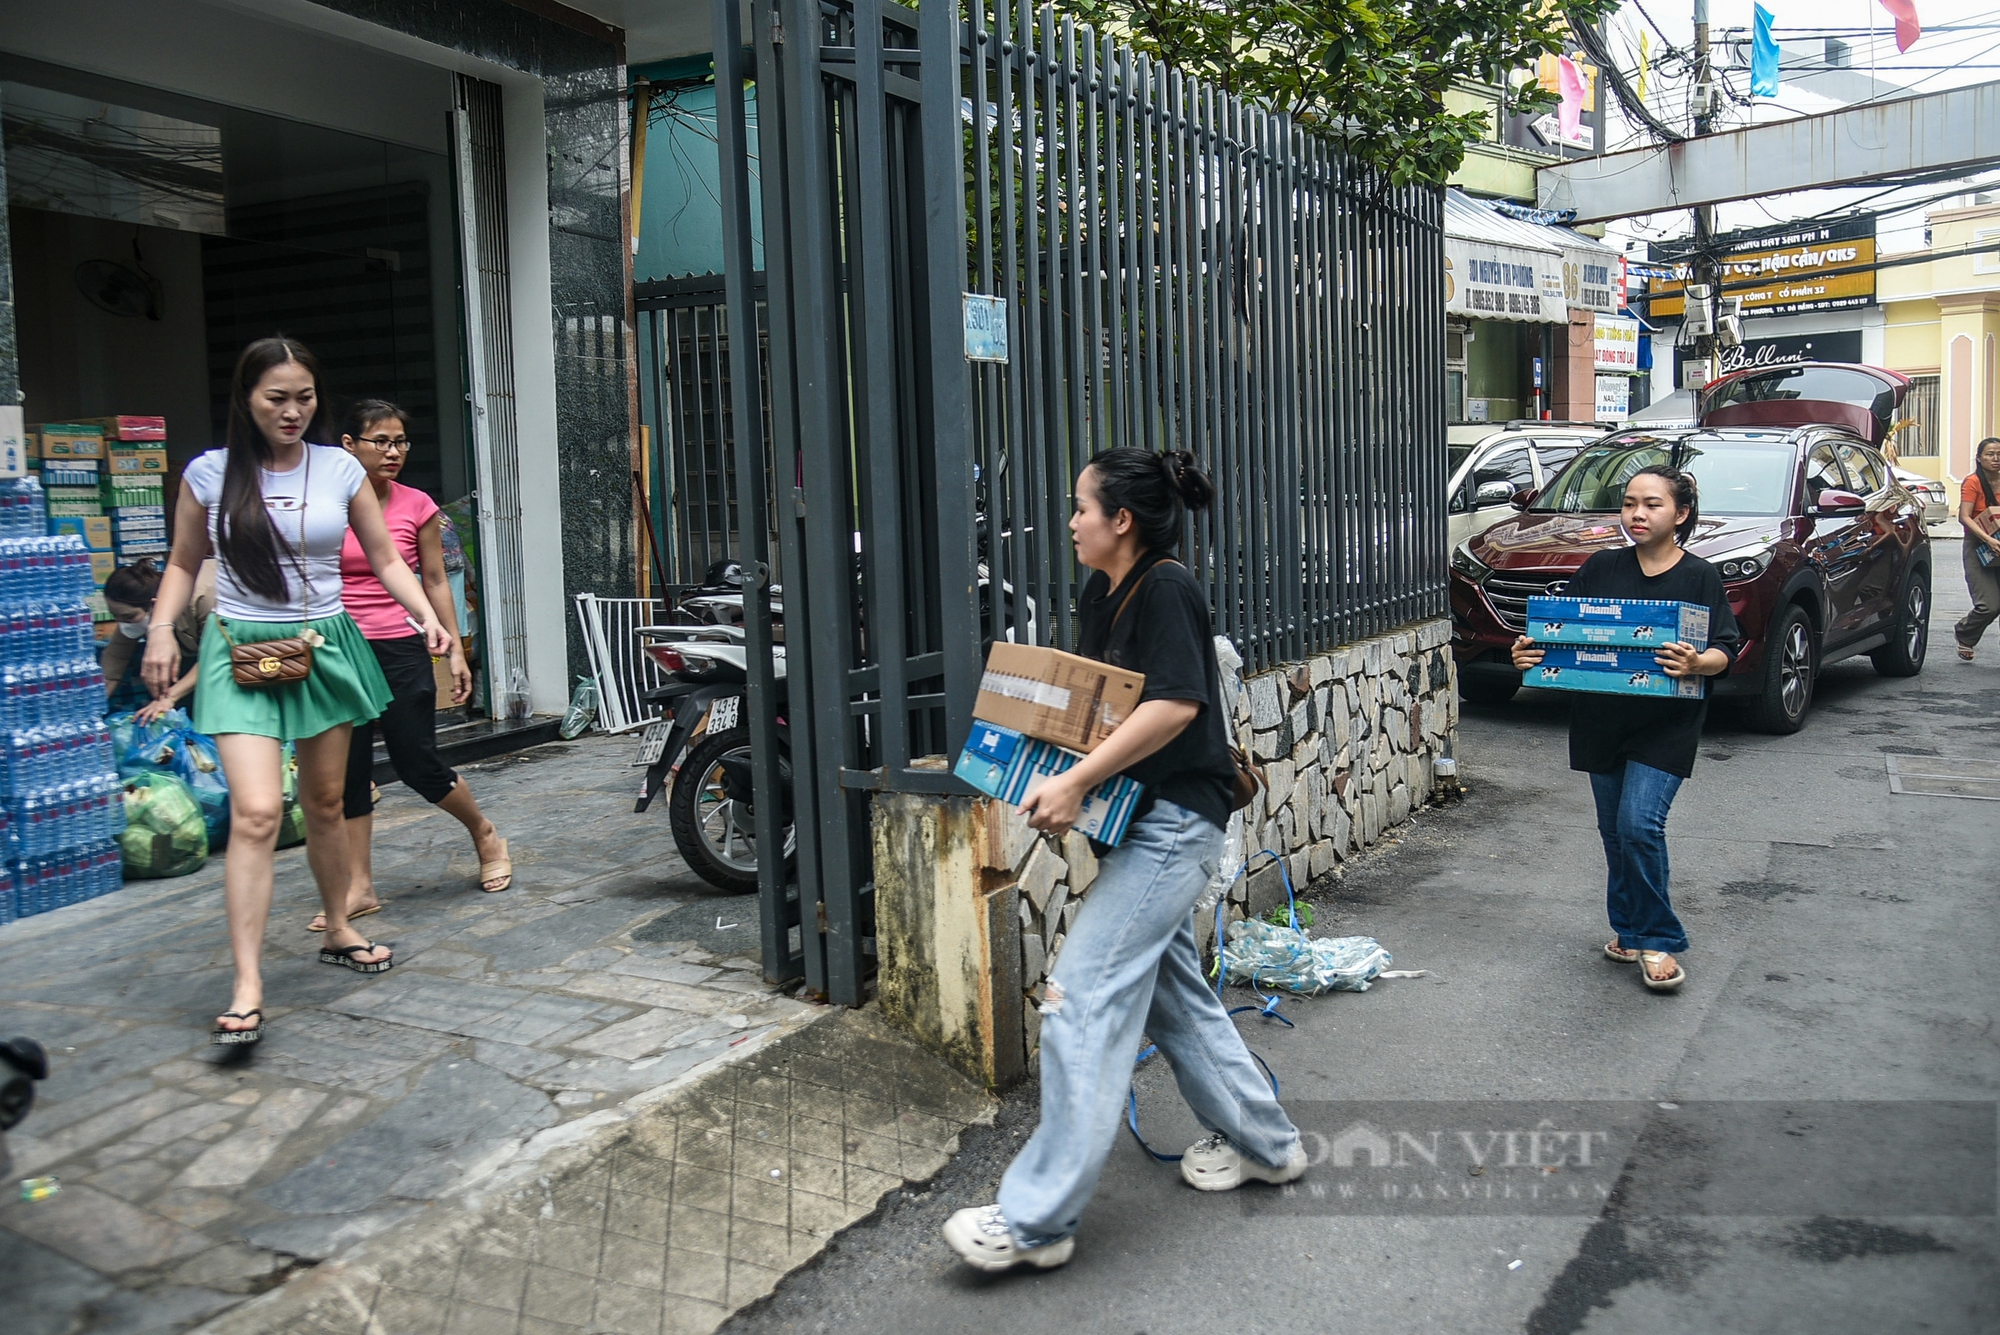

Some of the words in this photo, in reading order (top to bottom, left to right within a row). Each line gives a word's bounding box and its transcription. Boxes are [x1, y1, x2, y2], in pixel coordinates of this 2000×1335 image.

[1761, 253, 1790, 273] HẬU
[1563, 262, 1579, 301] 86
[1814, 286, 1825, 295] 32
[1603, 394, 1616, 403] NAIL
[1579, 603, 1622, 616] Vinamilk
[1575, 650, 1618, 663] Vinamilk
